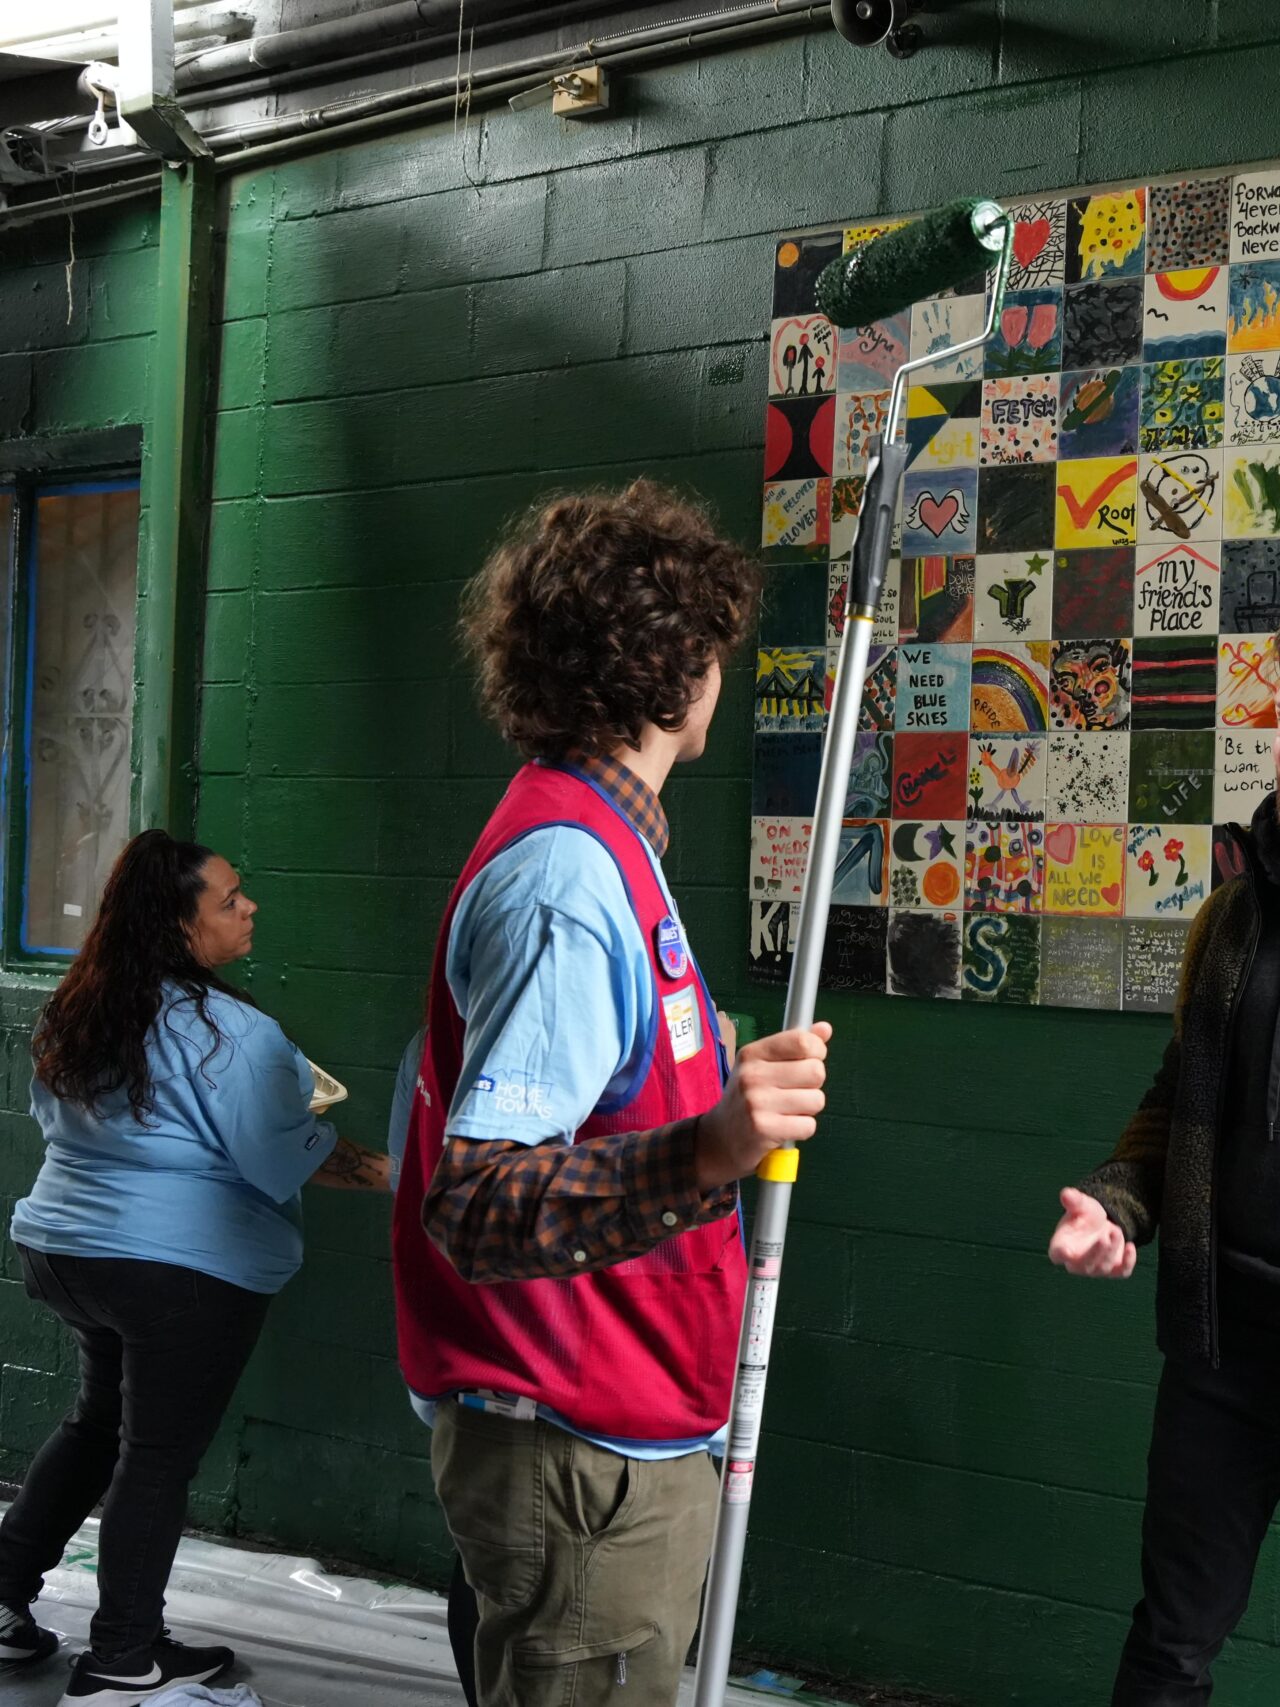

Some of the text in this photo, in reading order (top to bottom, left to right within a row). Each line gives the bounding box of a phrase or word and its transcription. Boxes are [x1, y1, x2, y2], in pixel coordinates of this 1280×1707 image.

[991, 396, 1057, 424] FETCH
[775, 507, 819, 548] ELOVED
[1157, 559, 1195, 591] my
[1138, 580, 1213, 610] friend's
[902, 649, 931, 664] WE
[909, 673, 944, 688] NEED
[914, 693, 948, 710] BLUE
[906, 711, 948, 726] SKIES
[974, 698, 1001, 728] PRIDE
[1224, 763, 1261, 774] want
[1161, 773, 1202, 818] LIFE
[1048, 870, 1071, 885] ALL
[496, 1082, 544, 1100] HOME
[495, 1096, 553, 1120] TOWNS
